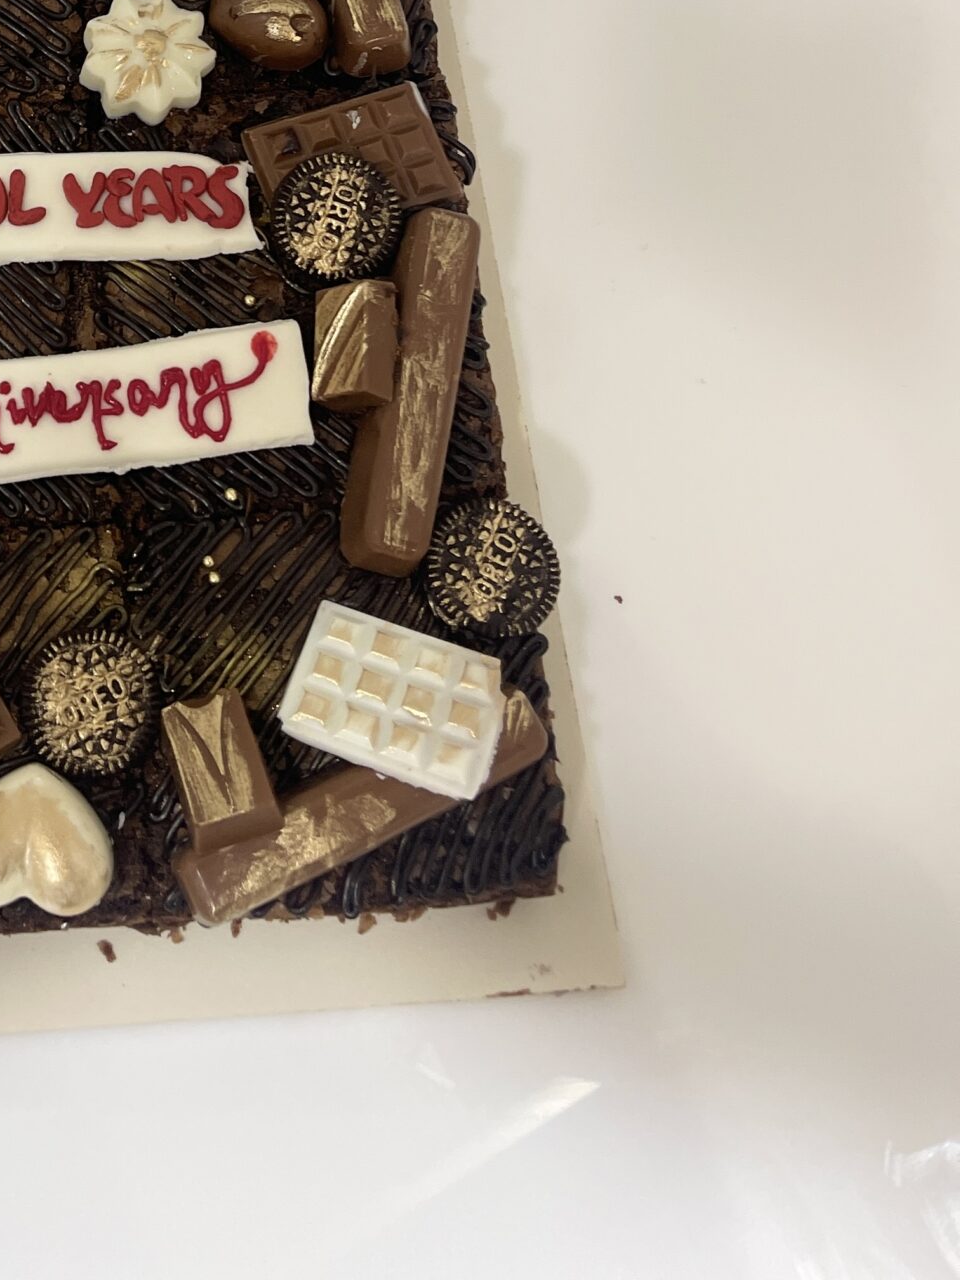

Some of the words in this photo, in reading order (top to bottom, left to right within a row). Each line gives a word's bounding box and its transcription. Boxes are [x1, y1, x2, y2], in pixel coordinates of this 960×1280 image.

[62, 164, 244, 230] YEARS
[319, 185, 358, 250] OREO
[471, 532, 518, 601] OREO
[59, 673, 127, 727] OREO
